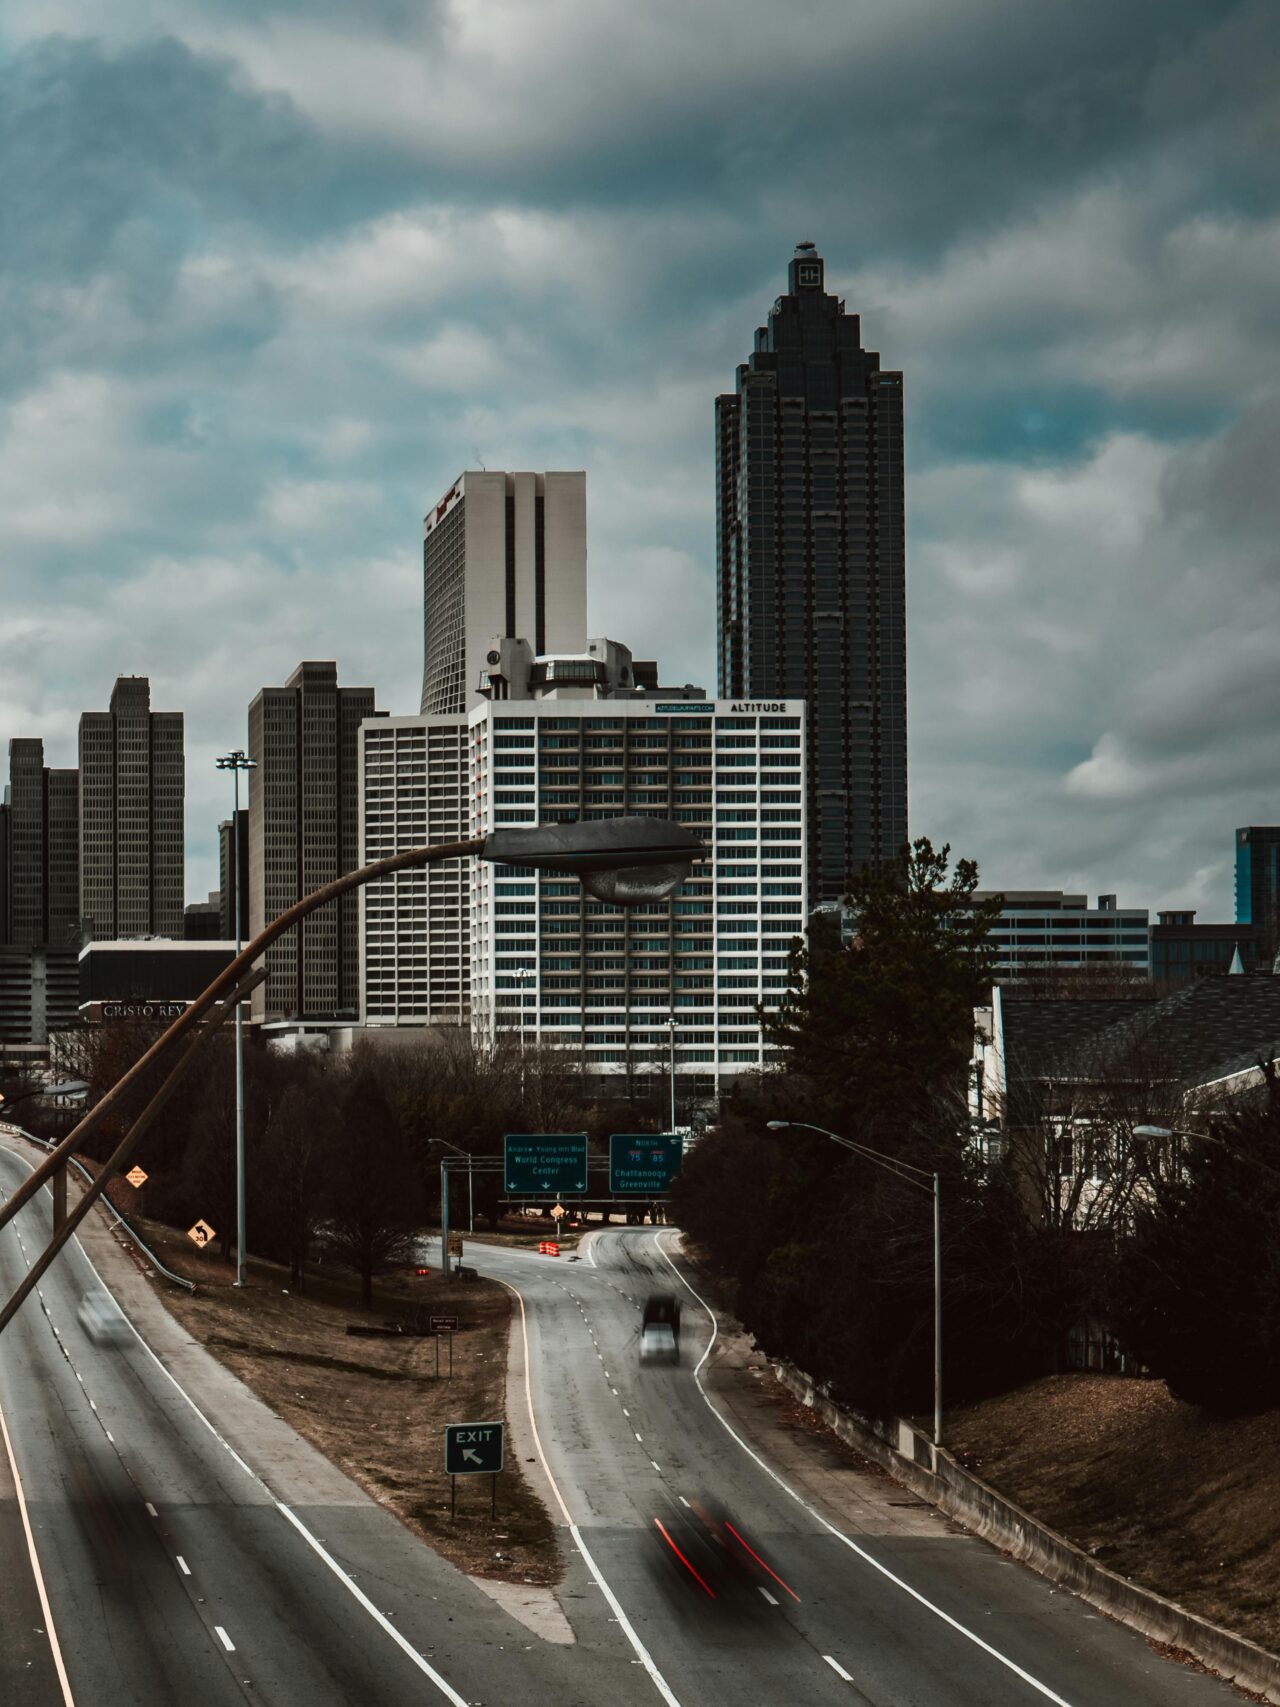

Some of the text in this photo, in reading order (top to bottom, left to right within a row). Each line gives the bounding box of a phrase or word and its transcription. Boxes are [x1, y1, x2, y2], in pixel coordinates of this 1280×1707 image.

[731, 703, 786, 713] ALTITUDE
[103, 1005, 184, 1017] CRISTO REY
[540, 1155, 577, 1165] Congress
[532, 1167, 560, 1175] Center
[615, 1169, 666, 1178] Chattanooga
[620, 1180, 660, 1188] Greenville
[455, 1430, 493, 1443] EXIT
